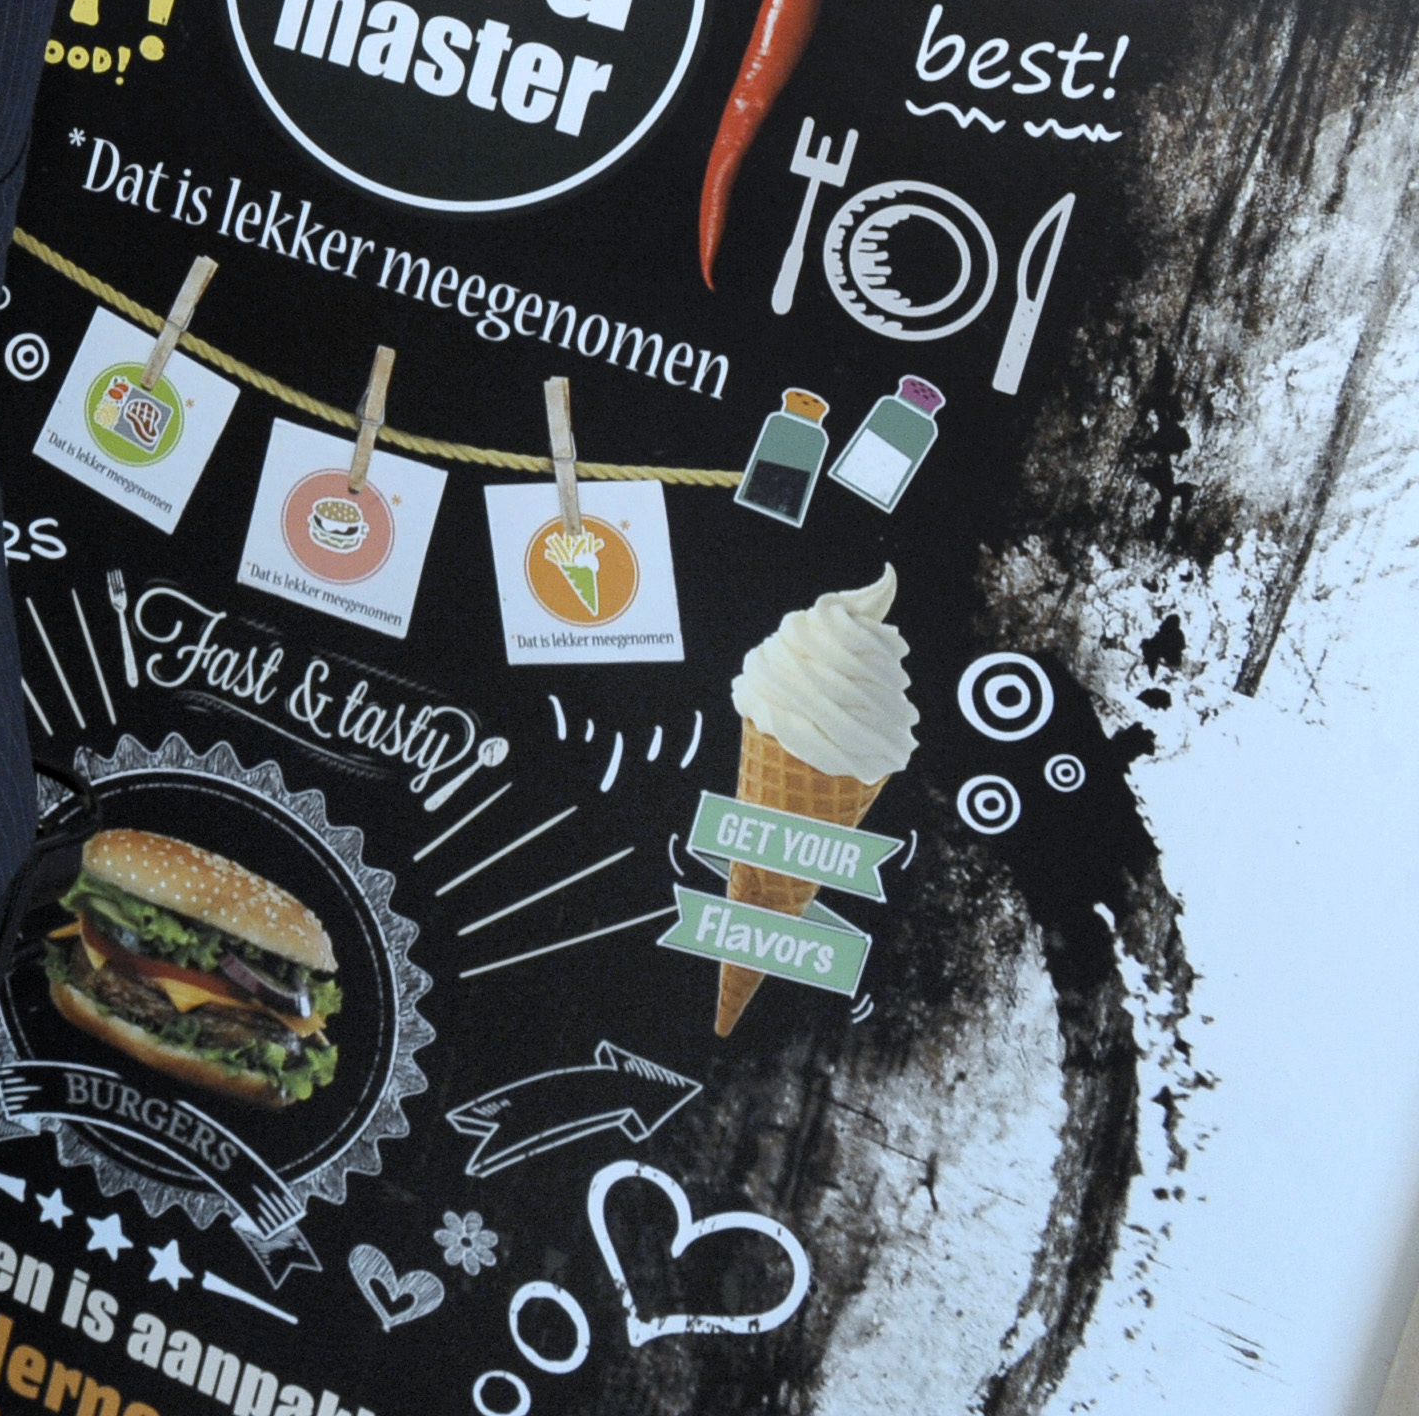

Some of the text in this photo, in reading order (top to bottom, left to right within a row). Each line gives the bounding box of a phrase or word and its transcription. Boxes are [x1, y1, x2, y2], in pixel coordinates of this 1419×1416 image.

[44, 39, 131, 86] OOD!
[915, 4, 1130, 100] best!
[171, 168, 213, 226] is
[218, 177, 375, 279] lekker
[377, 246, 729, 400] meegenomen
[66, 443, 75, 456] is
[75, 447, 108, 474] lekker
[105, 468, 173, 514] meegenomen
[272, 573, 282, 586] is
[284, 574, 321, 598] lekker
[322, 590, 402, 627] meegenomen
[541, 634, 550, 648] is
[552, 632, 589, 648] lekker
[592, 632, 675, 649] meegenomen
[135, 587, 475, 793] Fast & tasty
[716, 813, 861, 879] GET YOUR
[695, 904, 835, 974] Flavors
[64, 1071, 239, 1172] BURGERS
[61, 1268, 119, 1343] is
